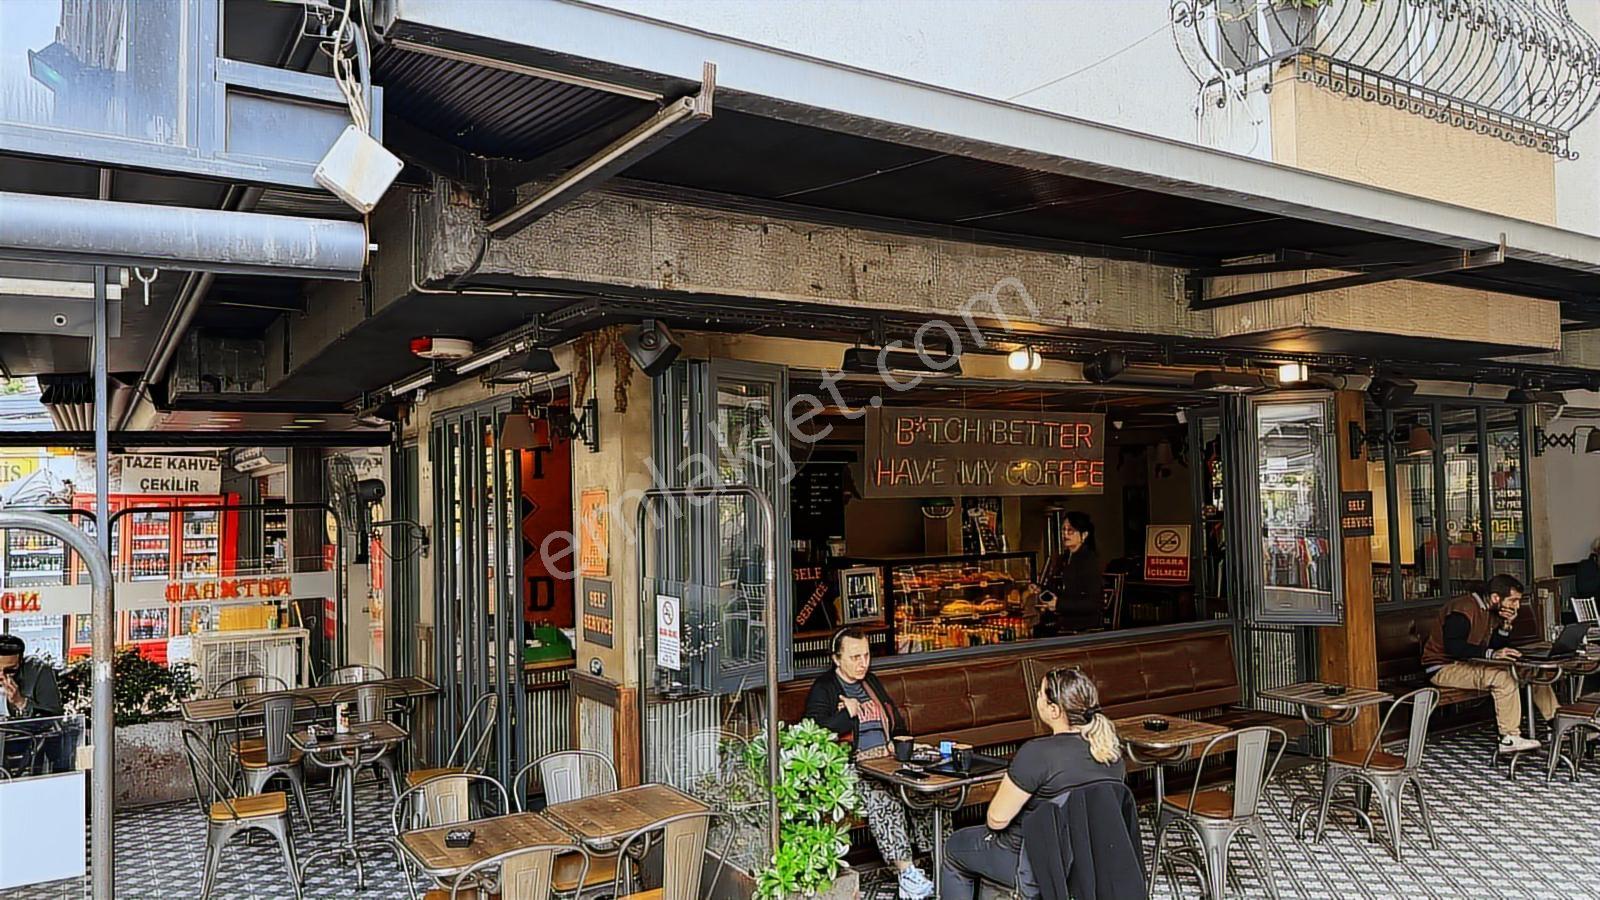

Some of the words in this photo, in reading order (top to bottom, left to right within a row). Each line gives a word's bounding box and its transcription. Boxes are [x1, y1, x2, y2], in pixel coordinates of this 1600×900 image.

[991, 419, 1093, 449] BETTER
[124, 456, 162, 469] TAZE
[167, 457, 219, 471] KAHVE
[876, 458, 947, 486] HAVE
[960, 459, 997, 485] MY
[1005, 459, 1105, 487] COFFEE
[140, 476, 199, 493] ÇEKİLİR
[1348, 500, 1365, 511] SELF
[1342, 516, 1372, 528] SERVICE
[793, 567, 822, 580] SELF
[589, 591, 607, 609] SELF
[796, 582, 828, 626] SERVICE
[584, 613, 612, 635] SERVICE
